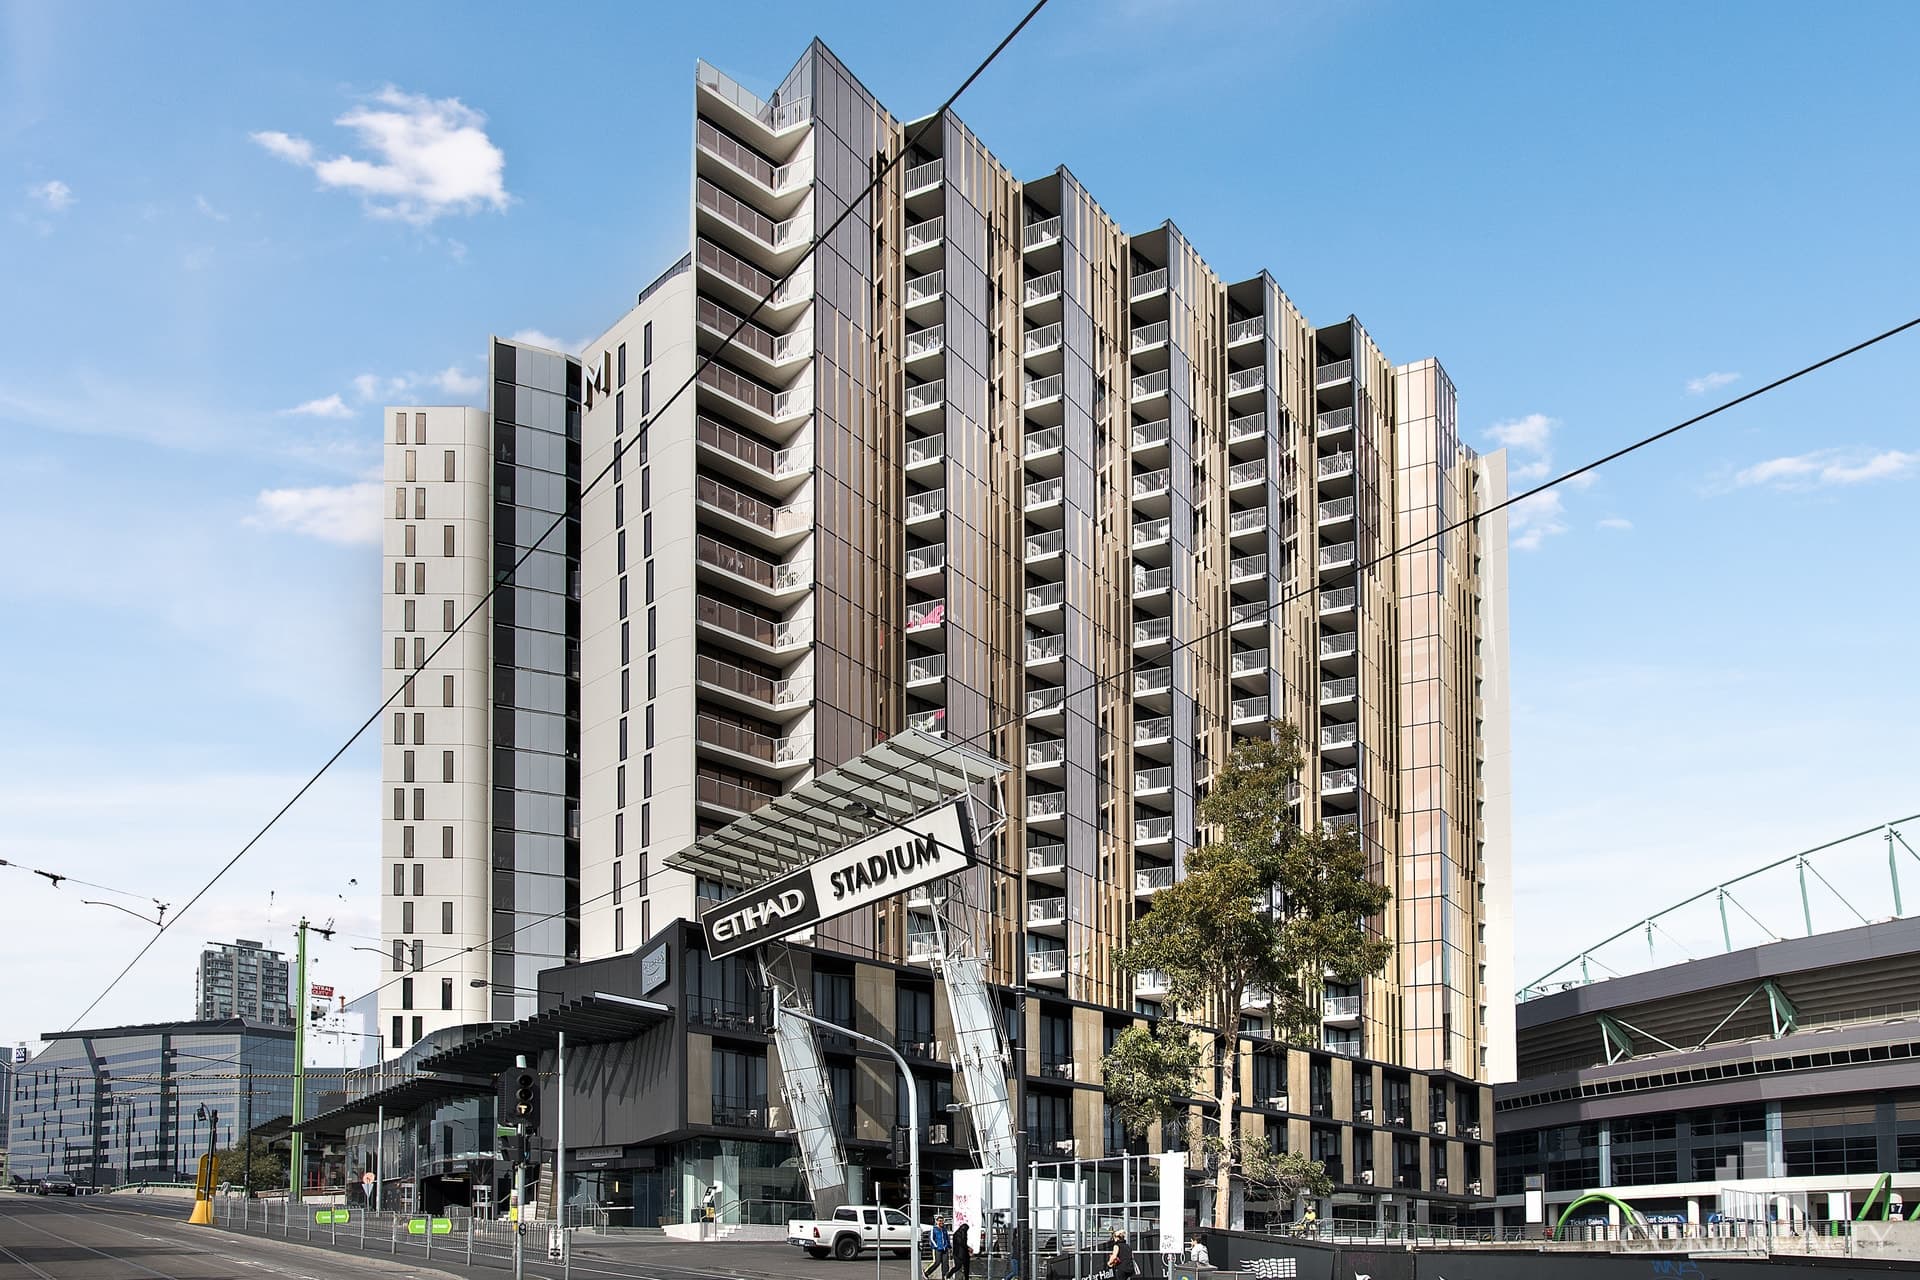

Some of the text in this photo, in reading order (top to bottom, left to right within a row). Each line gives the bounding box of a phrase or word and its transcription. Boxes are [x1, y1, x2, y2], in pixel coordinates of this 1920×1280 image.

[582, 351, 611, 412] M
[711, 832, 940, 942] ETIHAD STADIUM
[1587, 1217, 1604, 1226] Sales
[1657, 1215, 1679, 1224] Sales
